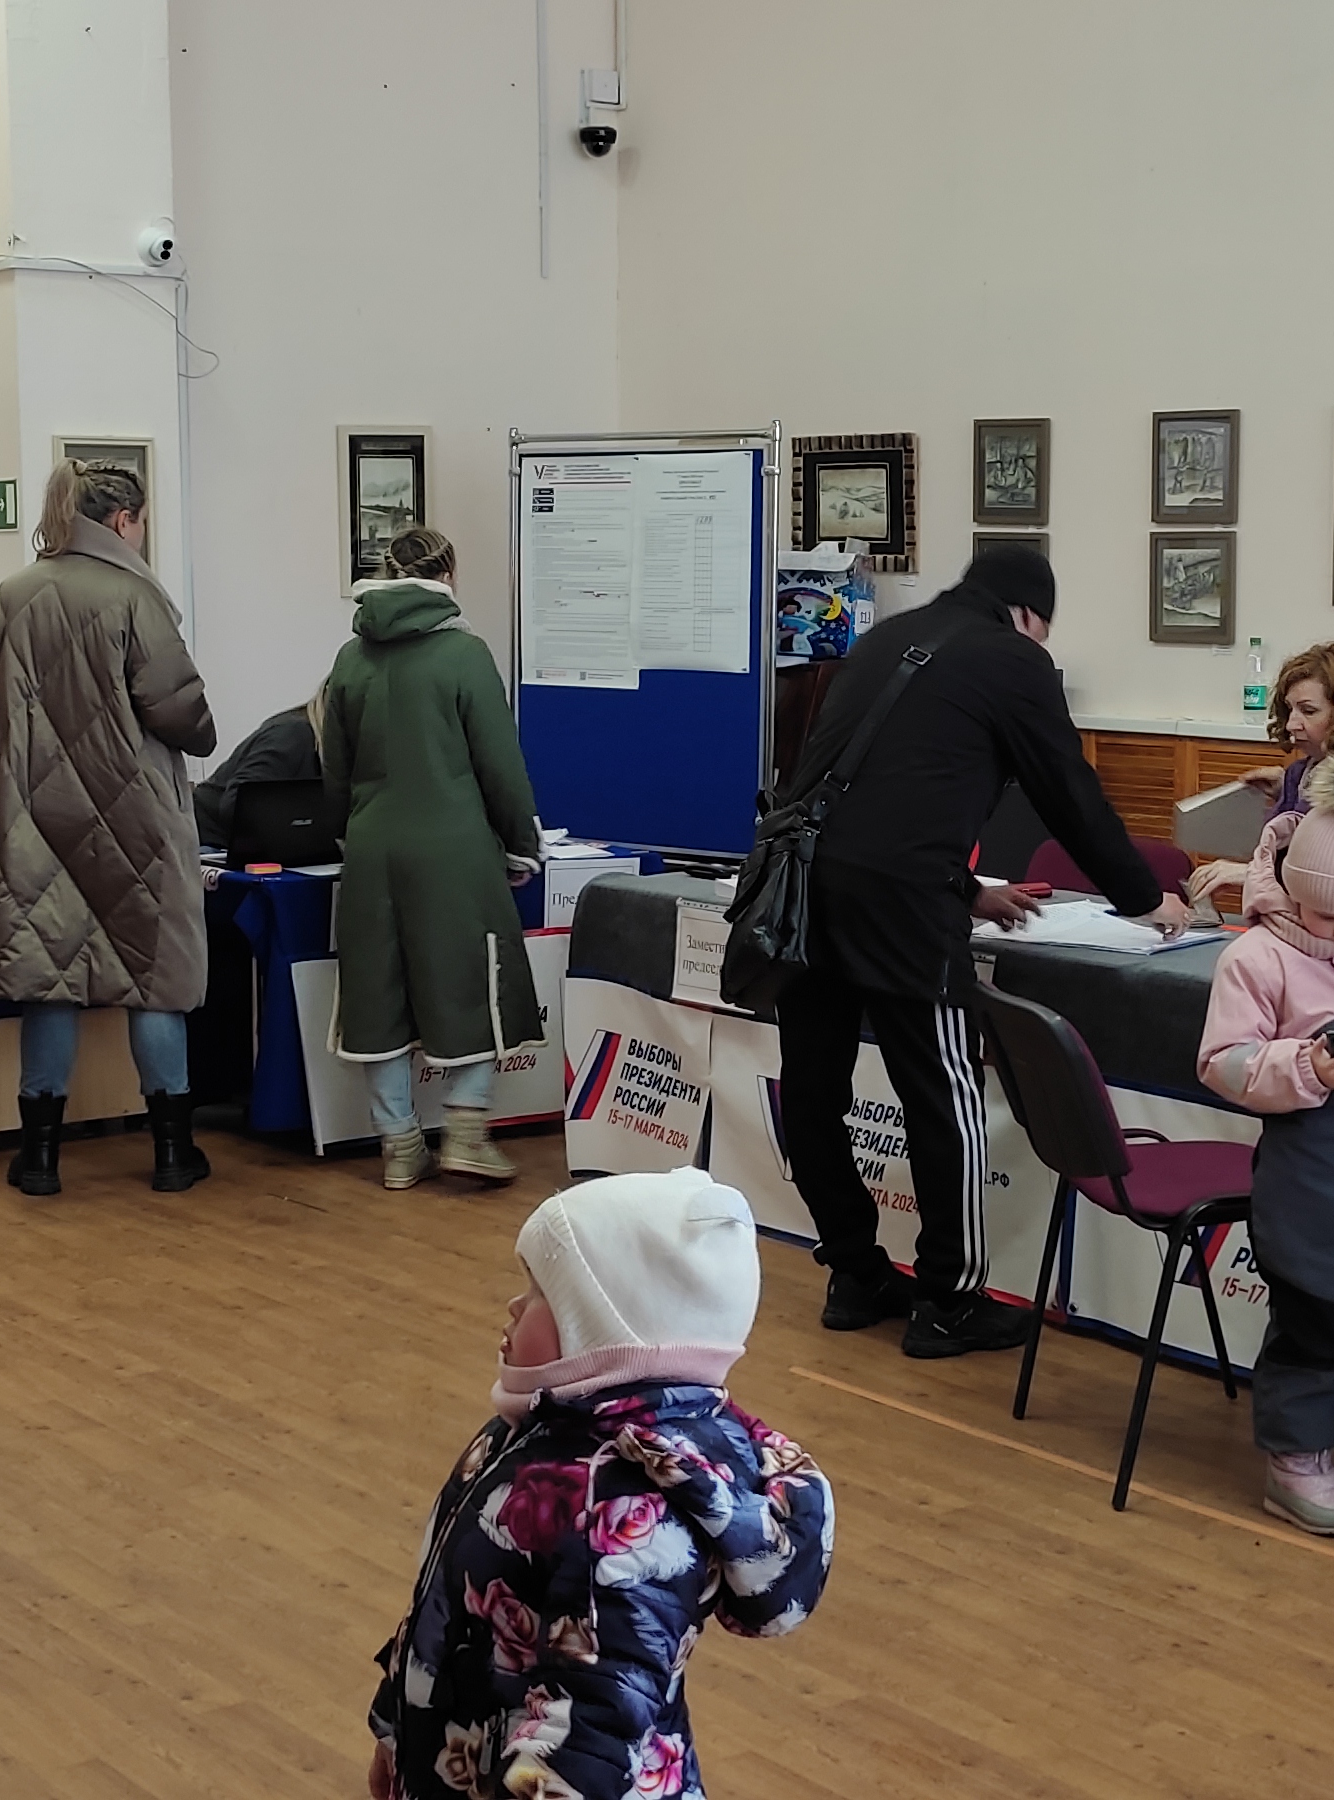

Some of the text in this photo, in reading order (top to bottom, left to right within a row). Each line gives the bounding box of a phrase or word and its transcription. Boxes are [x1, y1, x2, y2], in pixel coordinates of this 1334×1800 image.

[504, 1053, 537, 1073] 2024
[627, 1037, 682, 1073] ВЫБОРЫ
[619, 1061, 702, 1106] ПРЕЗИДЕНТА
[612, 1085, 667, 1119] РОССИИ
[633, 1117, 666, 1143] МАРТА
[666, 1129, 690, 1151] 2024
